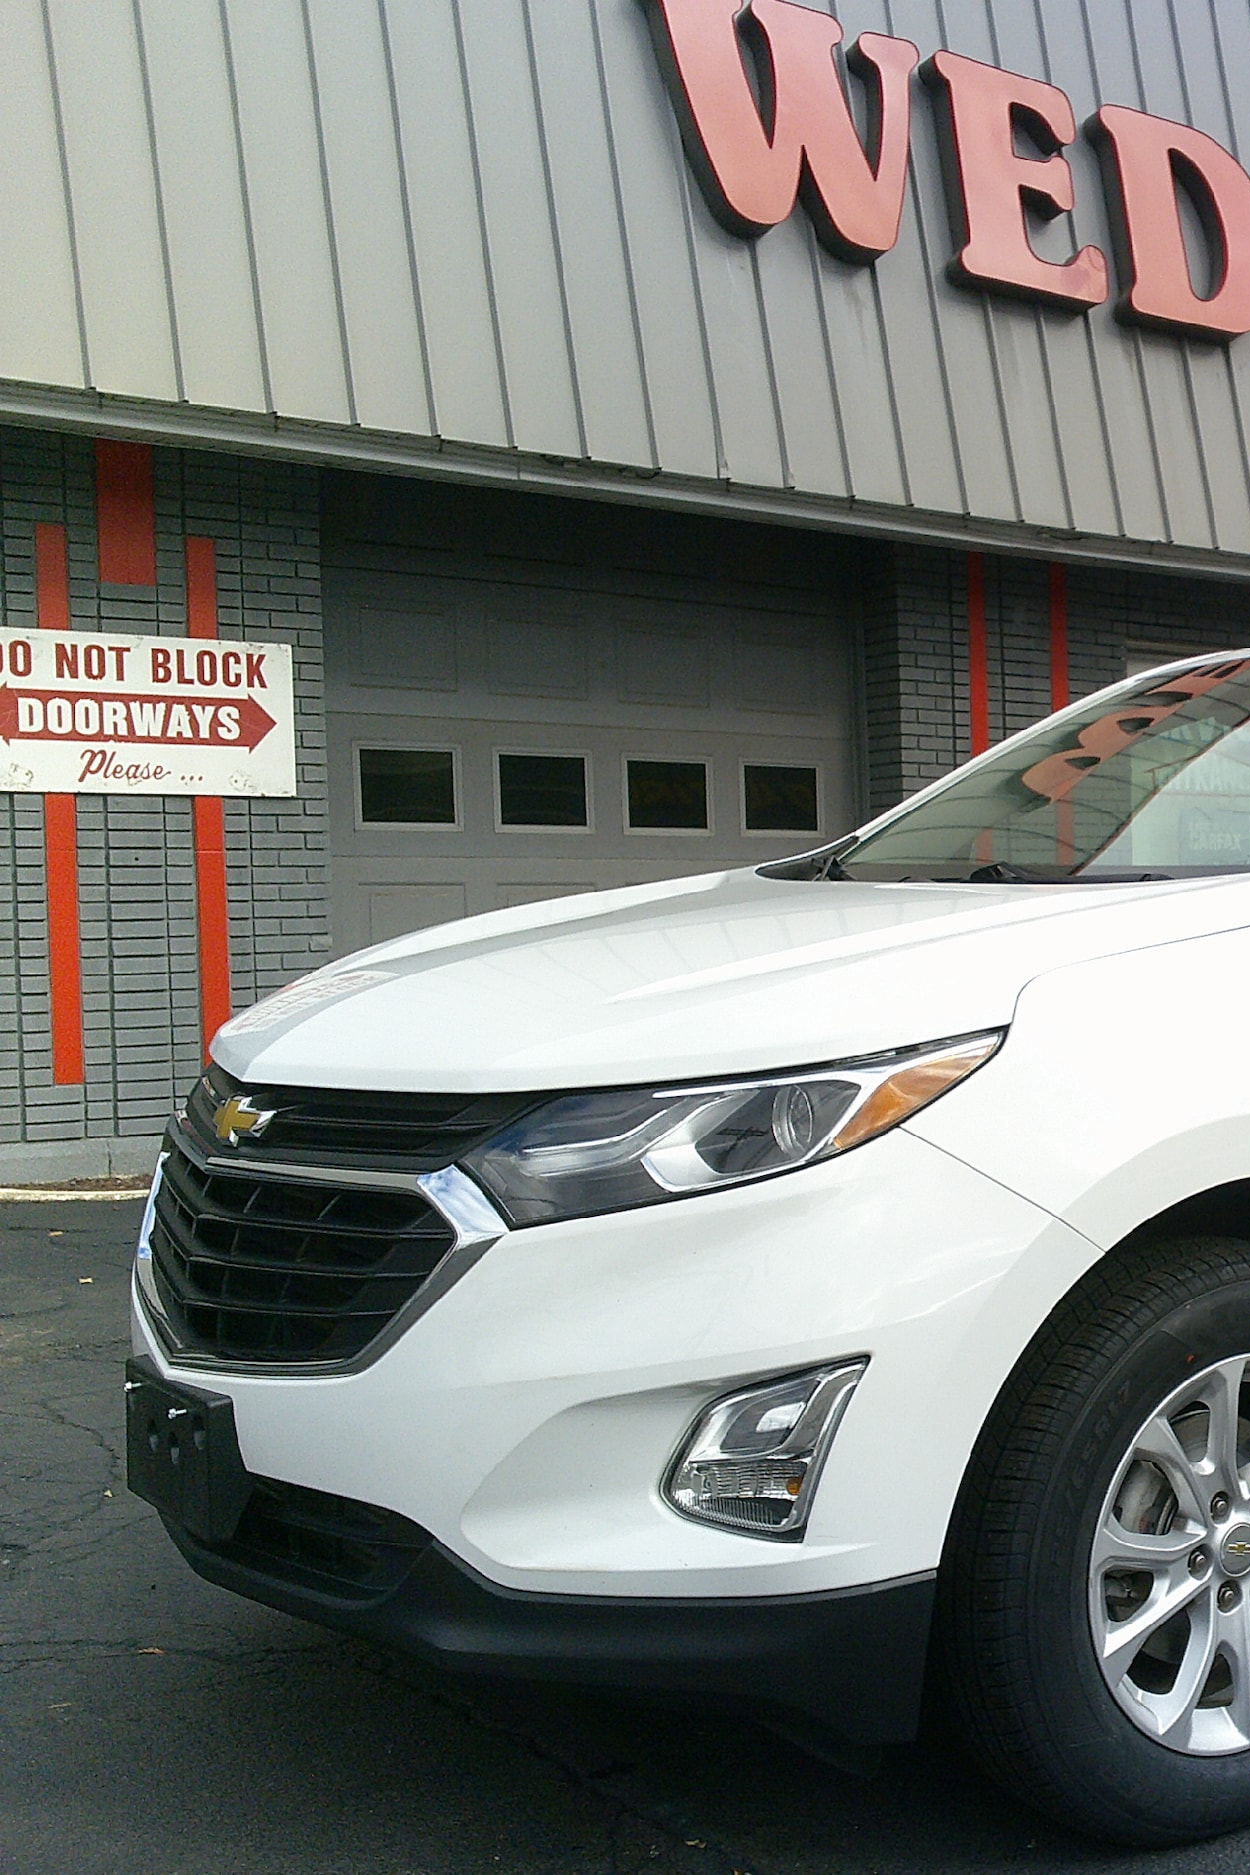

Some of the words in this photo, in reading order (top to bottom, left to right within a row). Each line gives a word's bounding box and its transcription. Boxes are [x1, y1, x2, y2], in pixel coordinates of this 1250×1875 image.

[0, 639, 32, 677] O
[55, 643, 131, 682] NOT
[151, 648, 268, 689] BLOCK
[17, 697, 242, 741] DOORWAYS
[78, 748, 172, 783] Please
